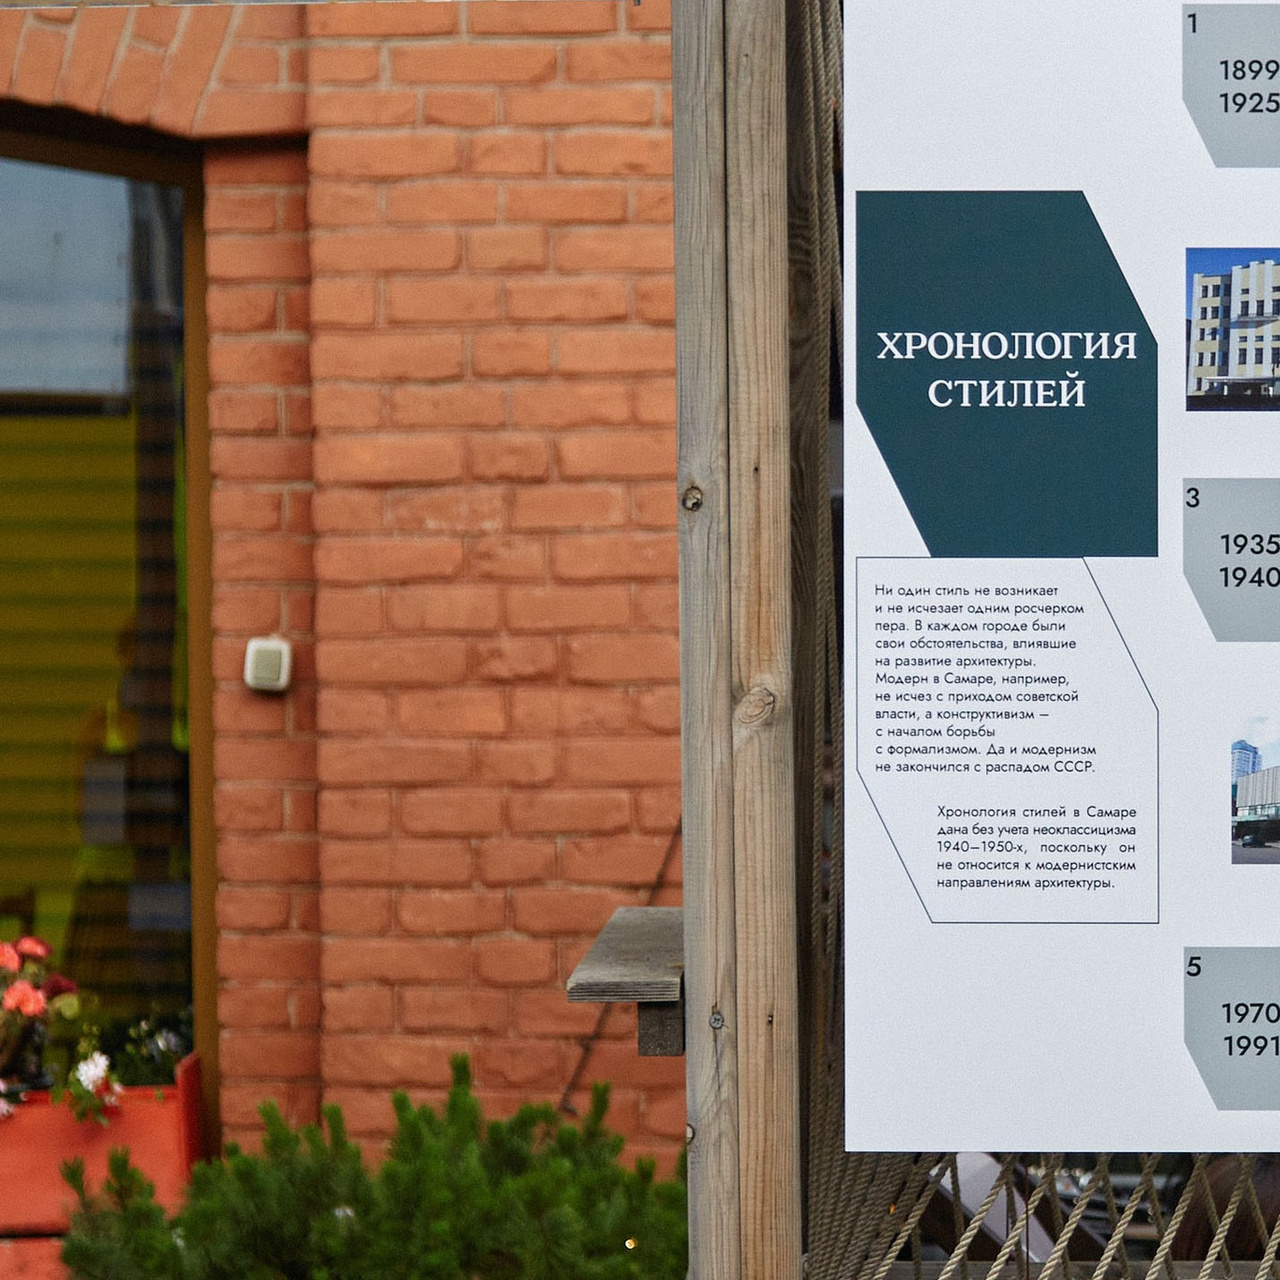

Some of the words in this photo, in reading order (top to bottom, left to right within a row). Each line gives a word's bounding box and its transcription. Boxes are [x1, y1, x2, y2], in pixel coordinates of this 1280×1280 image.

[1187, 12, 1197, 34] 1
[1219, 59, 1280, 81] 1899
[1219, 92, 1280, 114] 1925
[876, 331, 1137, 360] ХРОНОЛОГИЯ
[928, 370, 1086, 408] СТИЛЕЙ
[1185, 487, 1200, 508] 3
[1220, 533, 1280, 555] 1935
[874, 583, 893, 596] Ни
[897, 586, 931, 597] один
[934, 586, 970, 596] стиль
[974, 586, 991, 596] не
[994, 586, 1059, 596] возникает
[874, 604, 883, 613] и
[887, 603, 904, 614] не
[907, 603, 964, 614] исчезает
[967, 603, 1010, 615] одним
[1014, 603, 1085, 617] росчерком
[875, 621, 910, 634] пера.
[914, 617, 923, 631] В
[927, 621, 978, 632] каждом
[982, 621, 1028, 634] городе
[1031, 617, 1066, 632] были
[875, 638, 905, 649] свои
[909, 634, 1008, 651] обстоятельства,
[1012, 639, 1077, 650] влиявшие
[875, 656, 891, 667] на
[895, 656, 952, 670] развитие
[955, 656, 1036, 670] архитектуры.
[875, 671, 929, 687] Модерн
[933, 674, 940, 684] в
[943, 670, 997, 687] Самаре,
[1001, 674, 1070, 688] например,
[875, 691, 891, 702] не
[895, 691, 932, 702] исчез
[936, 691, 944, 702] с
[948, 692, 1013, 705] приходом
[1016, 689, 1079, 702] советской
[875, 709, 920, 721] власти,
[924, 709, 933, 720] а
[936, 709, 1035, 723] конструктивизм
[875, 727, 883, 737] с
[887, 727, 943, 737] началом
[946, 723, 996, 740] борьбы
[875, 744, 883, 755] с
[886, 743, 981, 758] формализмом.
[985, 742, 1005, 756] Да
[1009, 745, 1018, 755] и
[1021, 745, 1097, 758] модернизм
[875, 762, 892, 772] не
[895, 762, 970, 773] закончился
[973, 762, 981, 773] с
[985, 762, 1051, 775] распадом
[1053, 759, 1095, 773] СССР.
[937, 804, 1016, 820] Хронология
[1022, 804, 1066, 818] стилей
[1073, 807, 1080, 818] в
[1086, 804, 1137, 821] Самаре
[936, 825, 969, 836] дана
[971, 821, 995, 835] без
[997, 825, 1029, 838] учета
[1033, 825, 1137, 836] неоклассицизма
[1040, 843, 1108, 856] поскольку
[1118, 843, 1136, 853] он
[936, 860, 953, 871] не
[957, 860, 1020, 871] относится
[1024, 860, 1032, 871] к
[1035, 860, 1137, 874] модернистским
[936, 878, 1031, 891] направлениям
[1034, 878, 1115, 891] архитектуры.
[1186, 956, 1202, 977] 5
[1223, 1035, 1280, 1057] 1991
